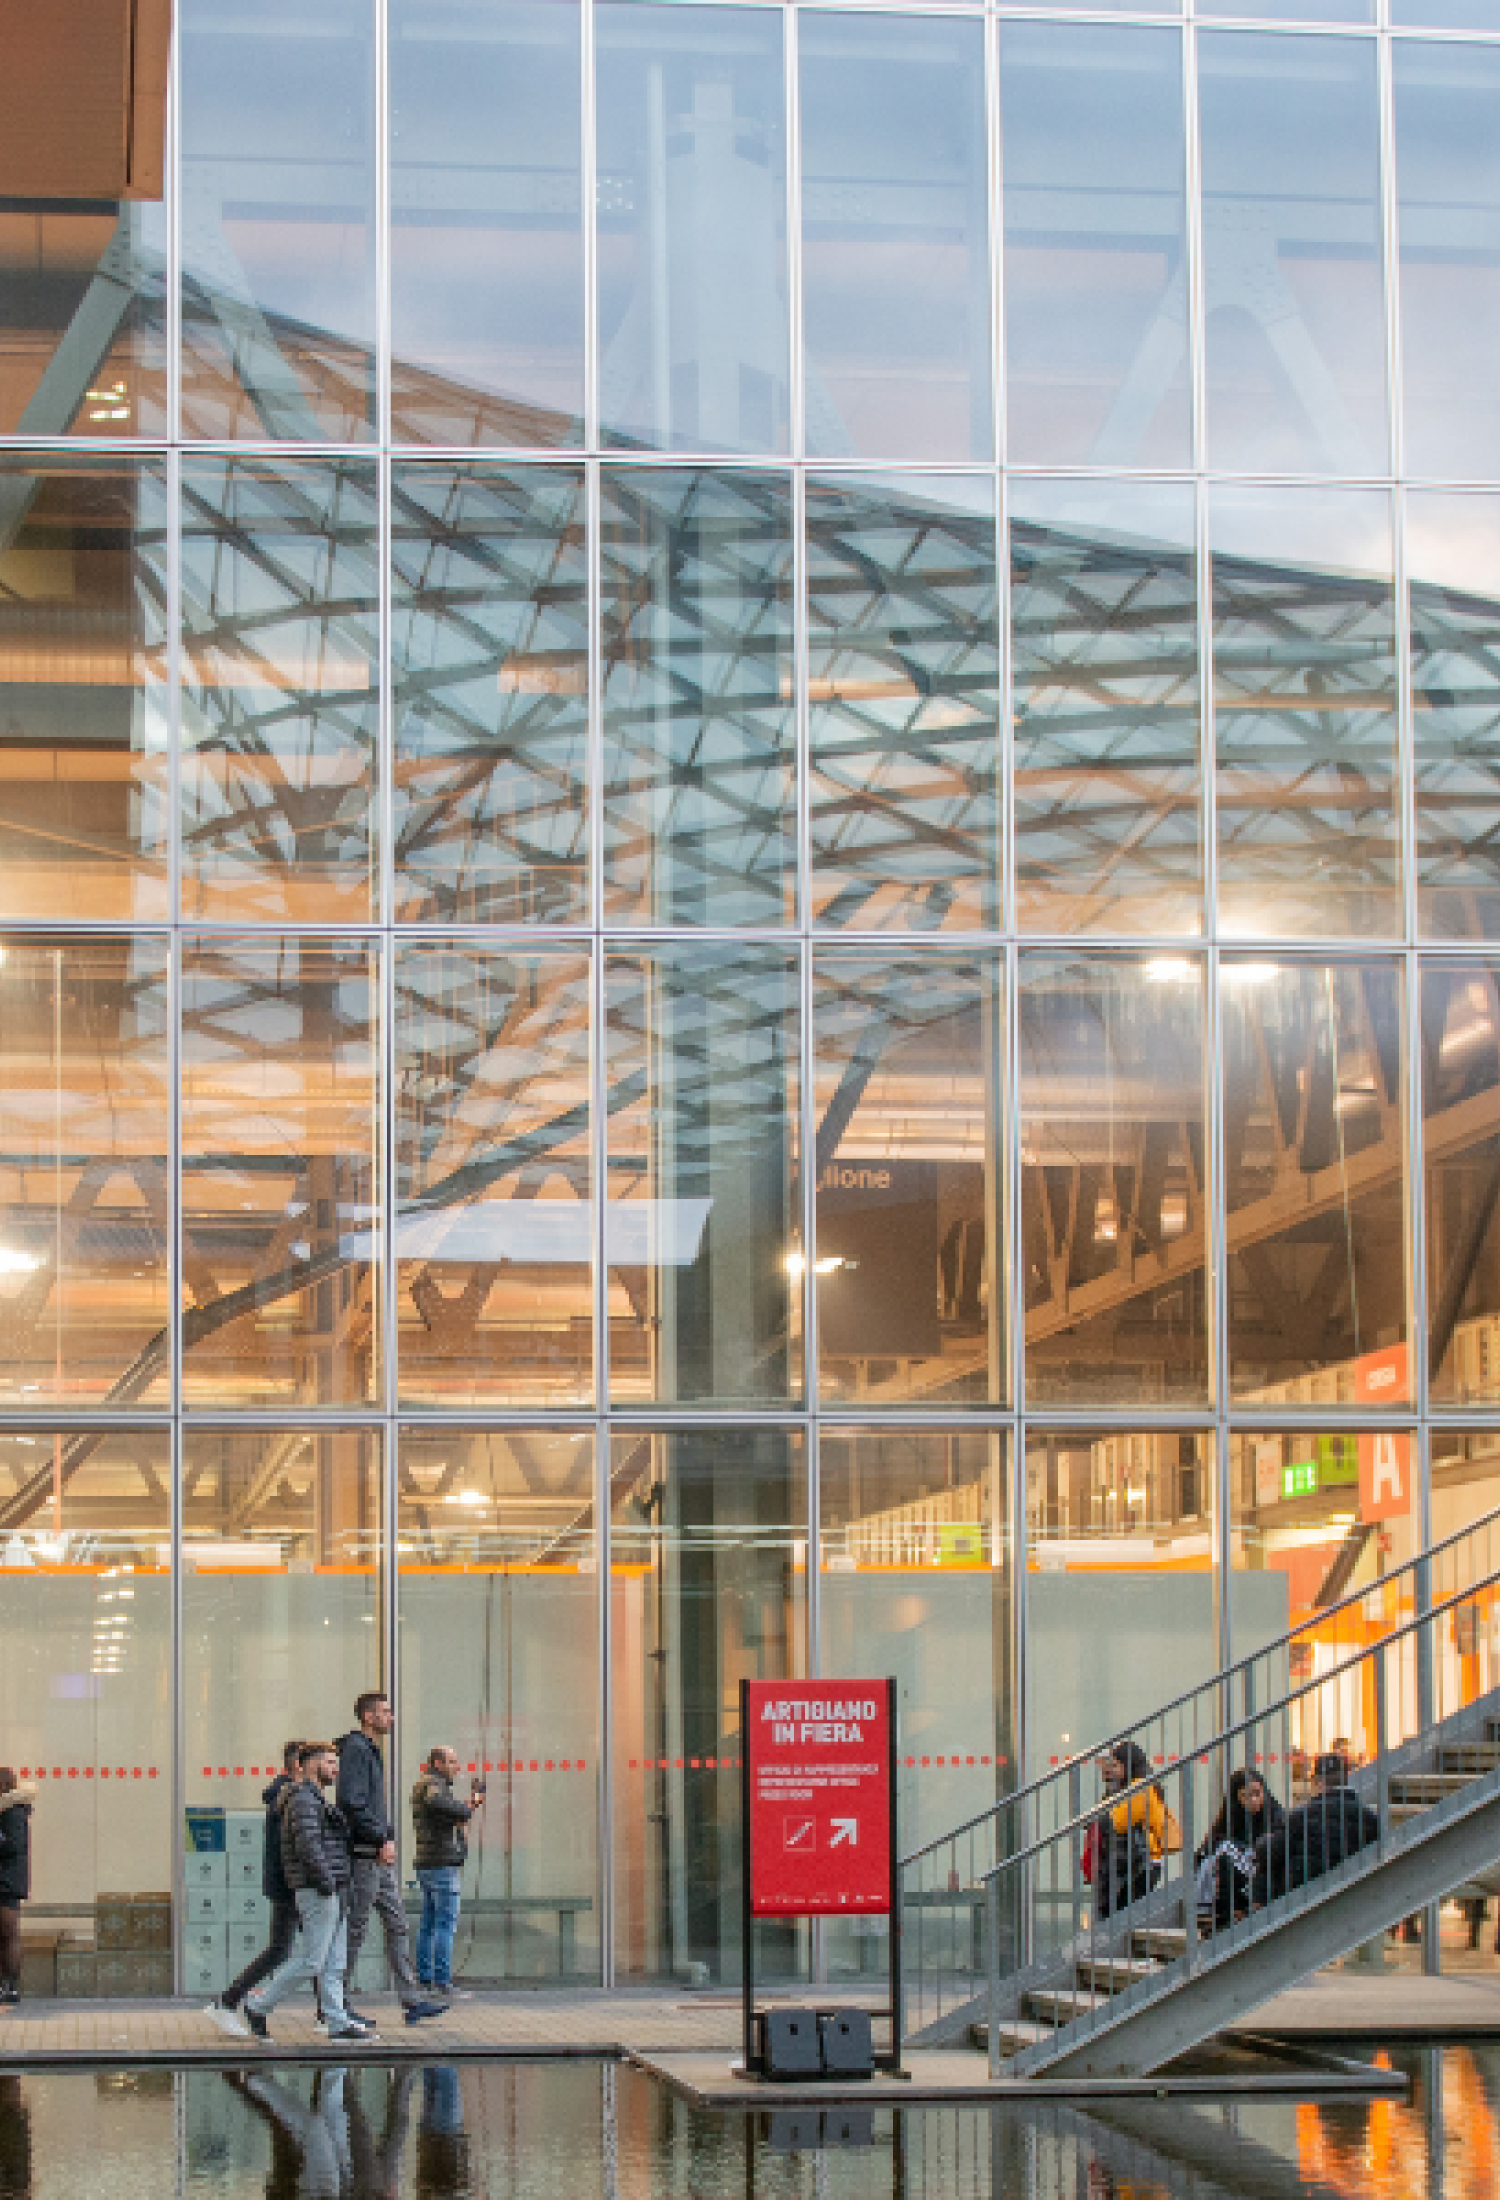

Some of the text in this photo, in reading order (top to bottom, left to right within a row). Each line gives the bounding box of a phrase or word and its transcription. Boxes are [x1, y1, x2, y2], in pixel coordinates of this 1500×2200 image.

[1373, 1432, 1404, 1503] A
[760, 1700, 877, 1721] ARTIGIANO
[773, 1722, 865, 1743] IN FIERA
